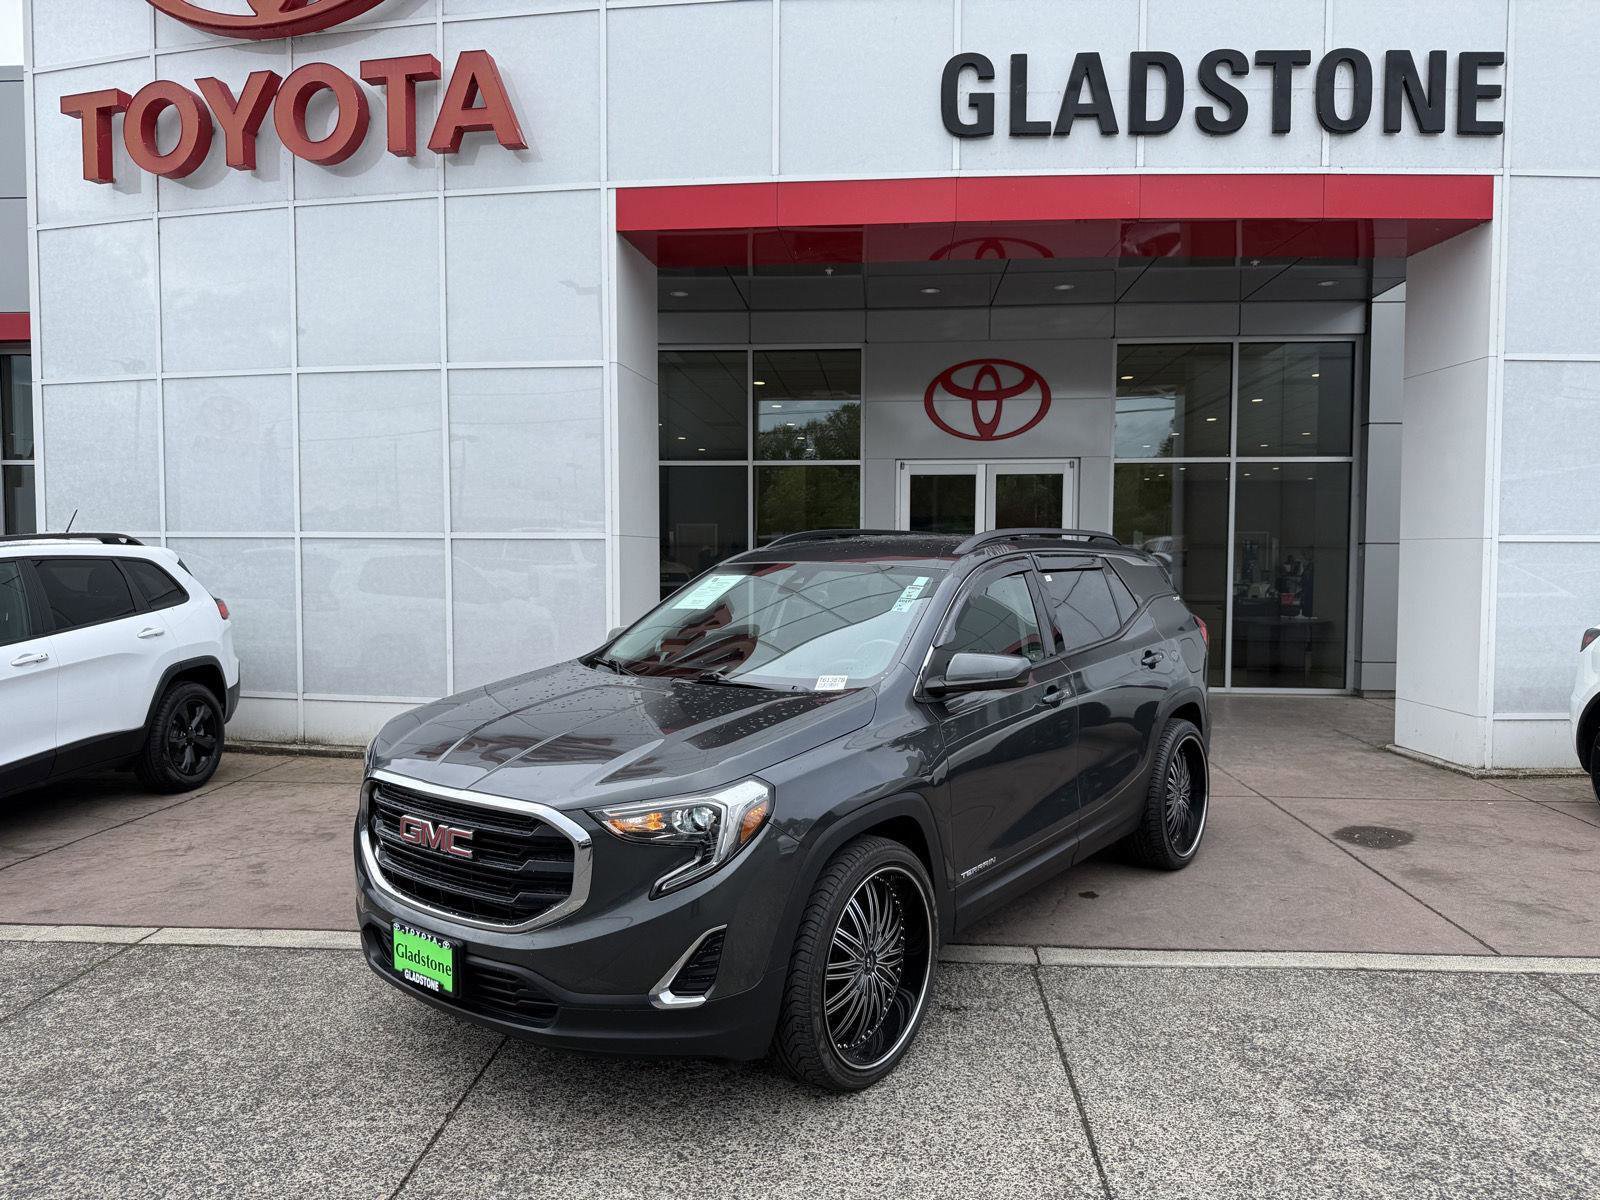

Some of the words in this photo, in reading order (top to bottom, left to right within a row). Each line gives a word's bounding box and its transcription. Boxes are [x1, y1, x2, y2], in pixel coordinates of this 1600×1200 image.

[940, 47, 1505, 138] GLADSTONE
[60, 49, 529, 185] TOYOTA
[400, 815, 473, 858] GMC
[960, 857, 996, 878] TERRAIN
[405, 926, 438, 945] TOYOTA
[395, 942, 452, 977] Gladstone
[404, 969, 439, 991] GLADSTONE
